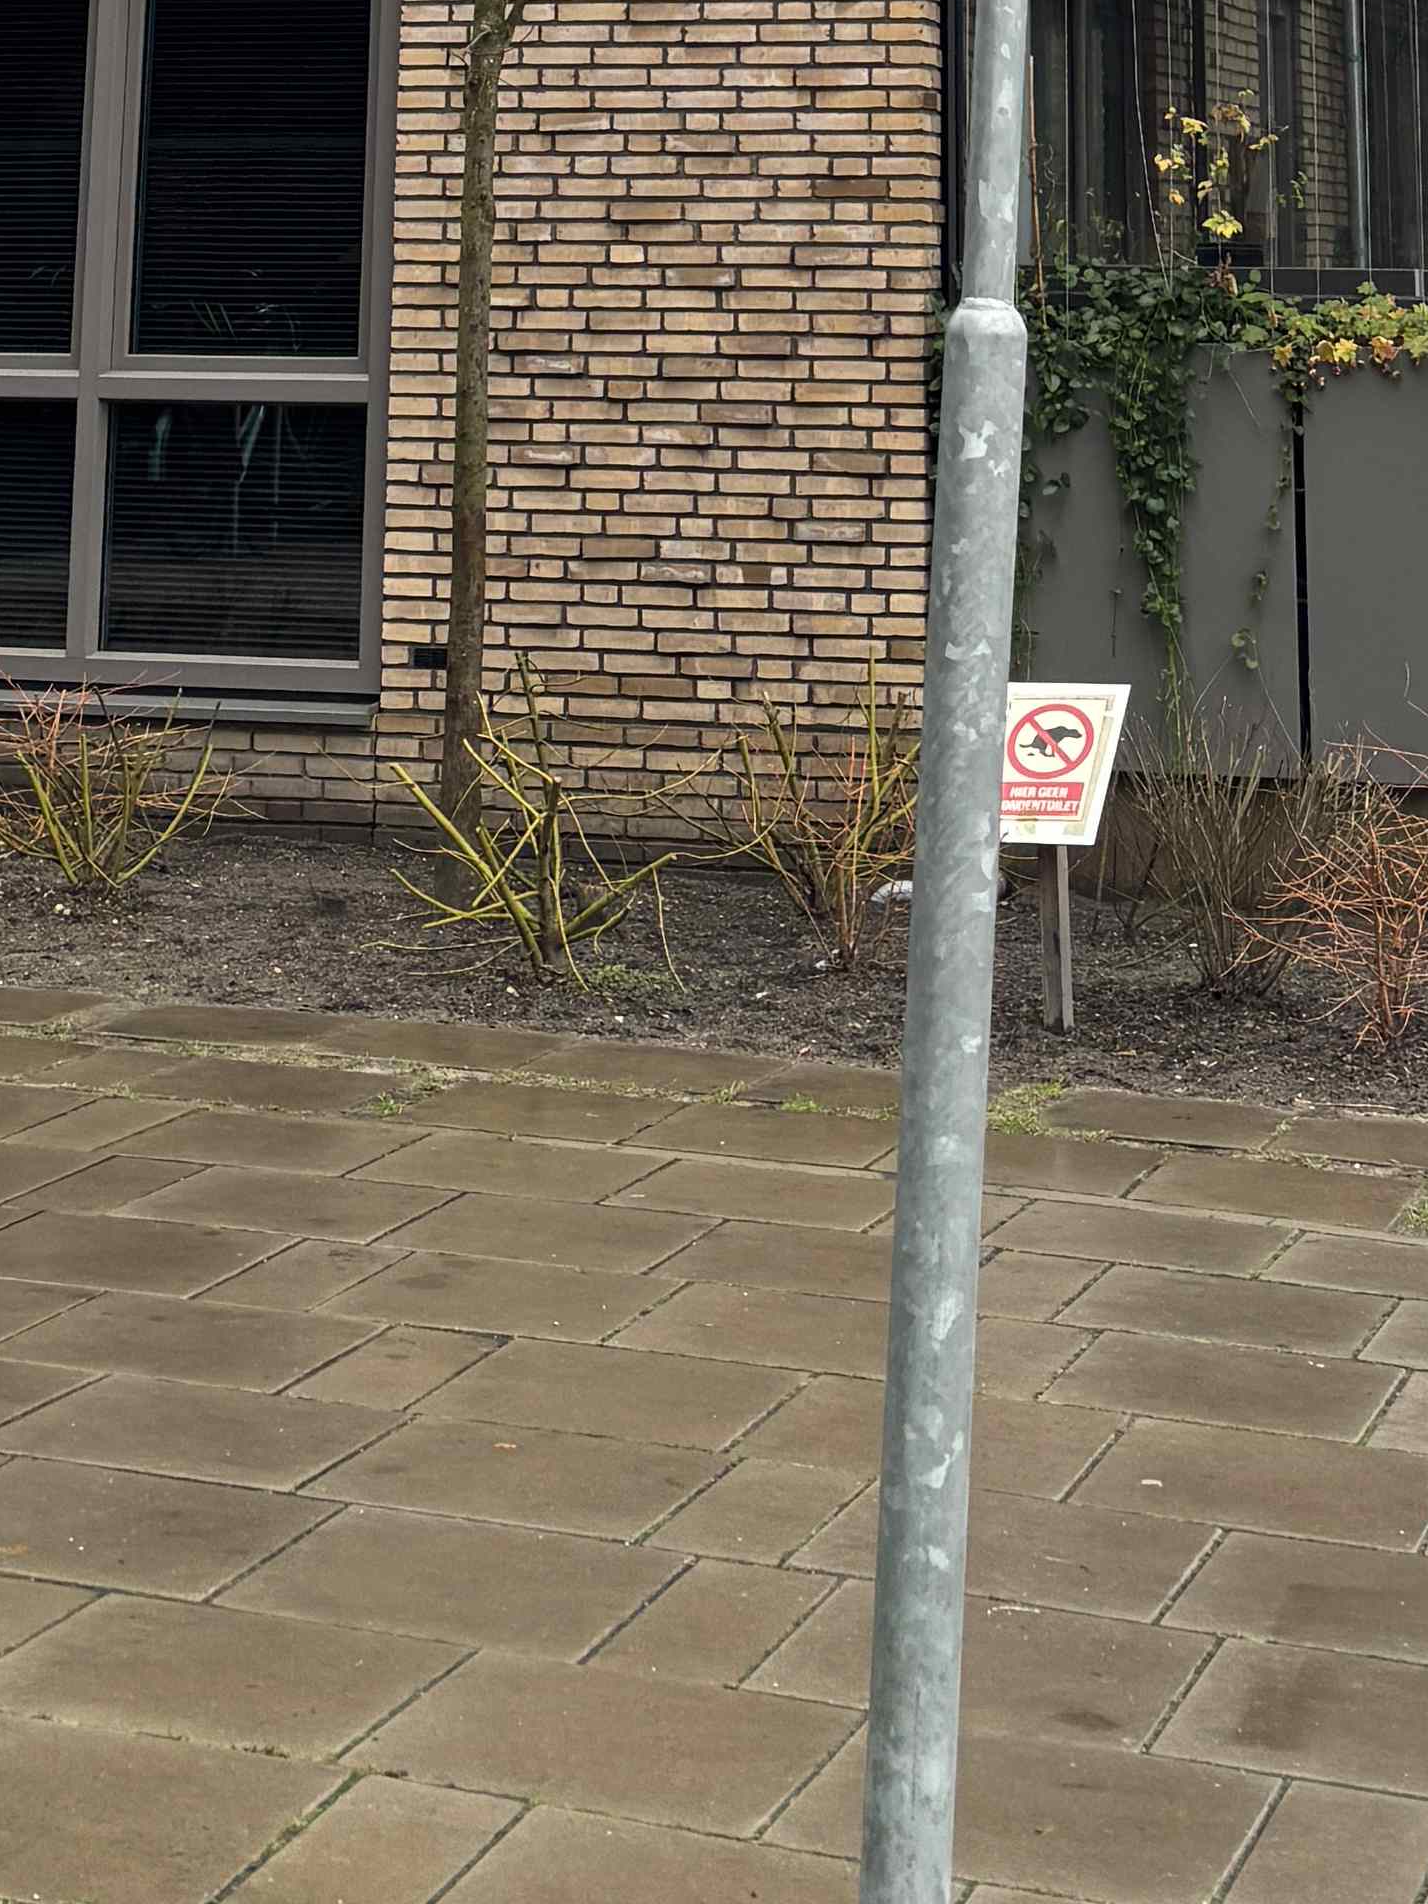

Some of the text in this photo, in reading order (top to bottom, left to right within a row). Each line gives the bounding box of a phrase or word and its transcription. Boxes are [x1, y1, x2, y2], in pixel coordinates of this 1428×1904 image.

[1009, 786, 1069, 799] HIER GEEN
[1001, 799, 1079, 811] ONDENTOILET
